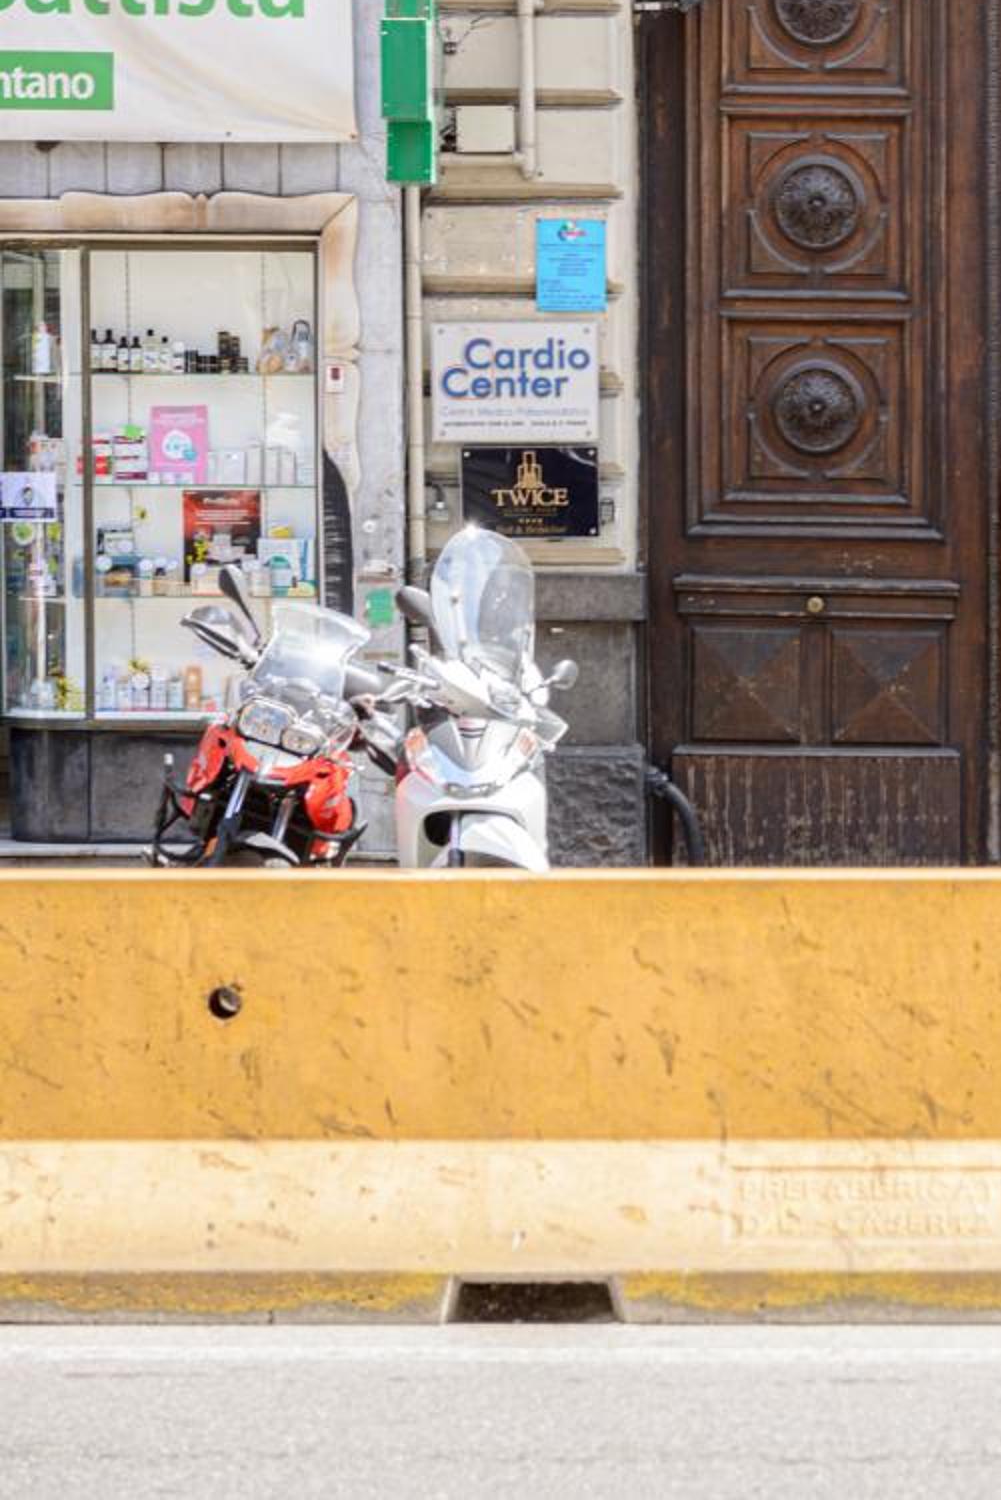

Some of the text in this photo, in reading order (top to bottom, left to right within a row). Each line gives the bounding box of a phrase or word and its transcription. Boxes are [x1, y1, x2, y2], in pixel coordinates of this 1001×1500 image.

[464, 338, 591, 370] Cardio
[441, 367, 569, 398] Center
[490, 486, 570, 508] TWICE
